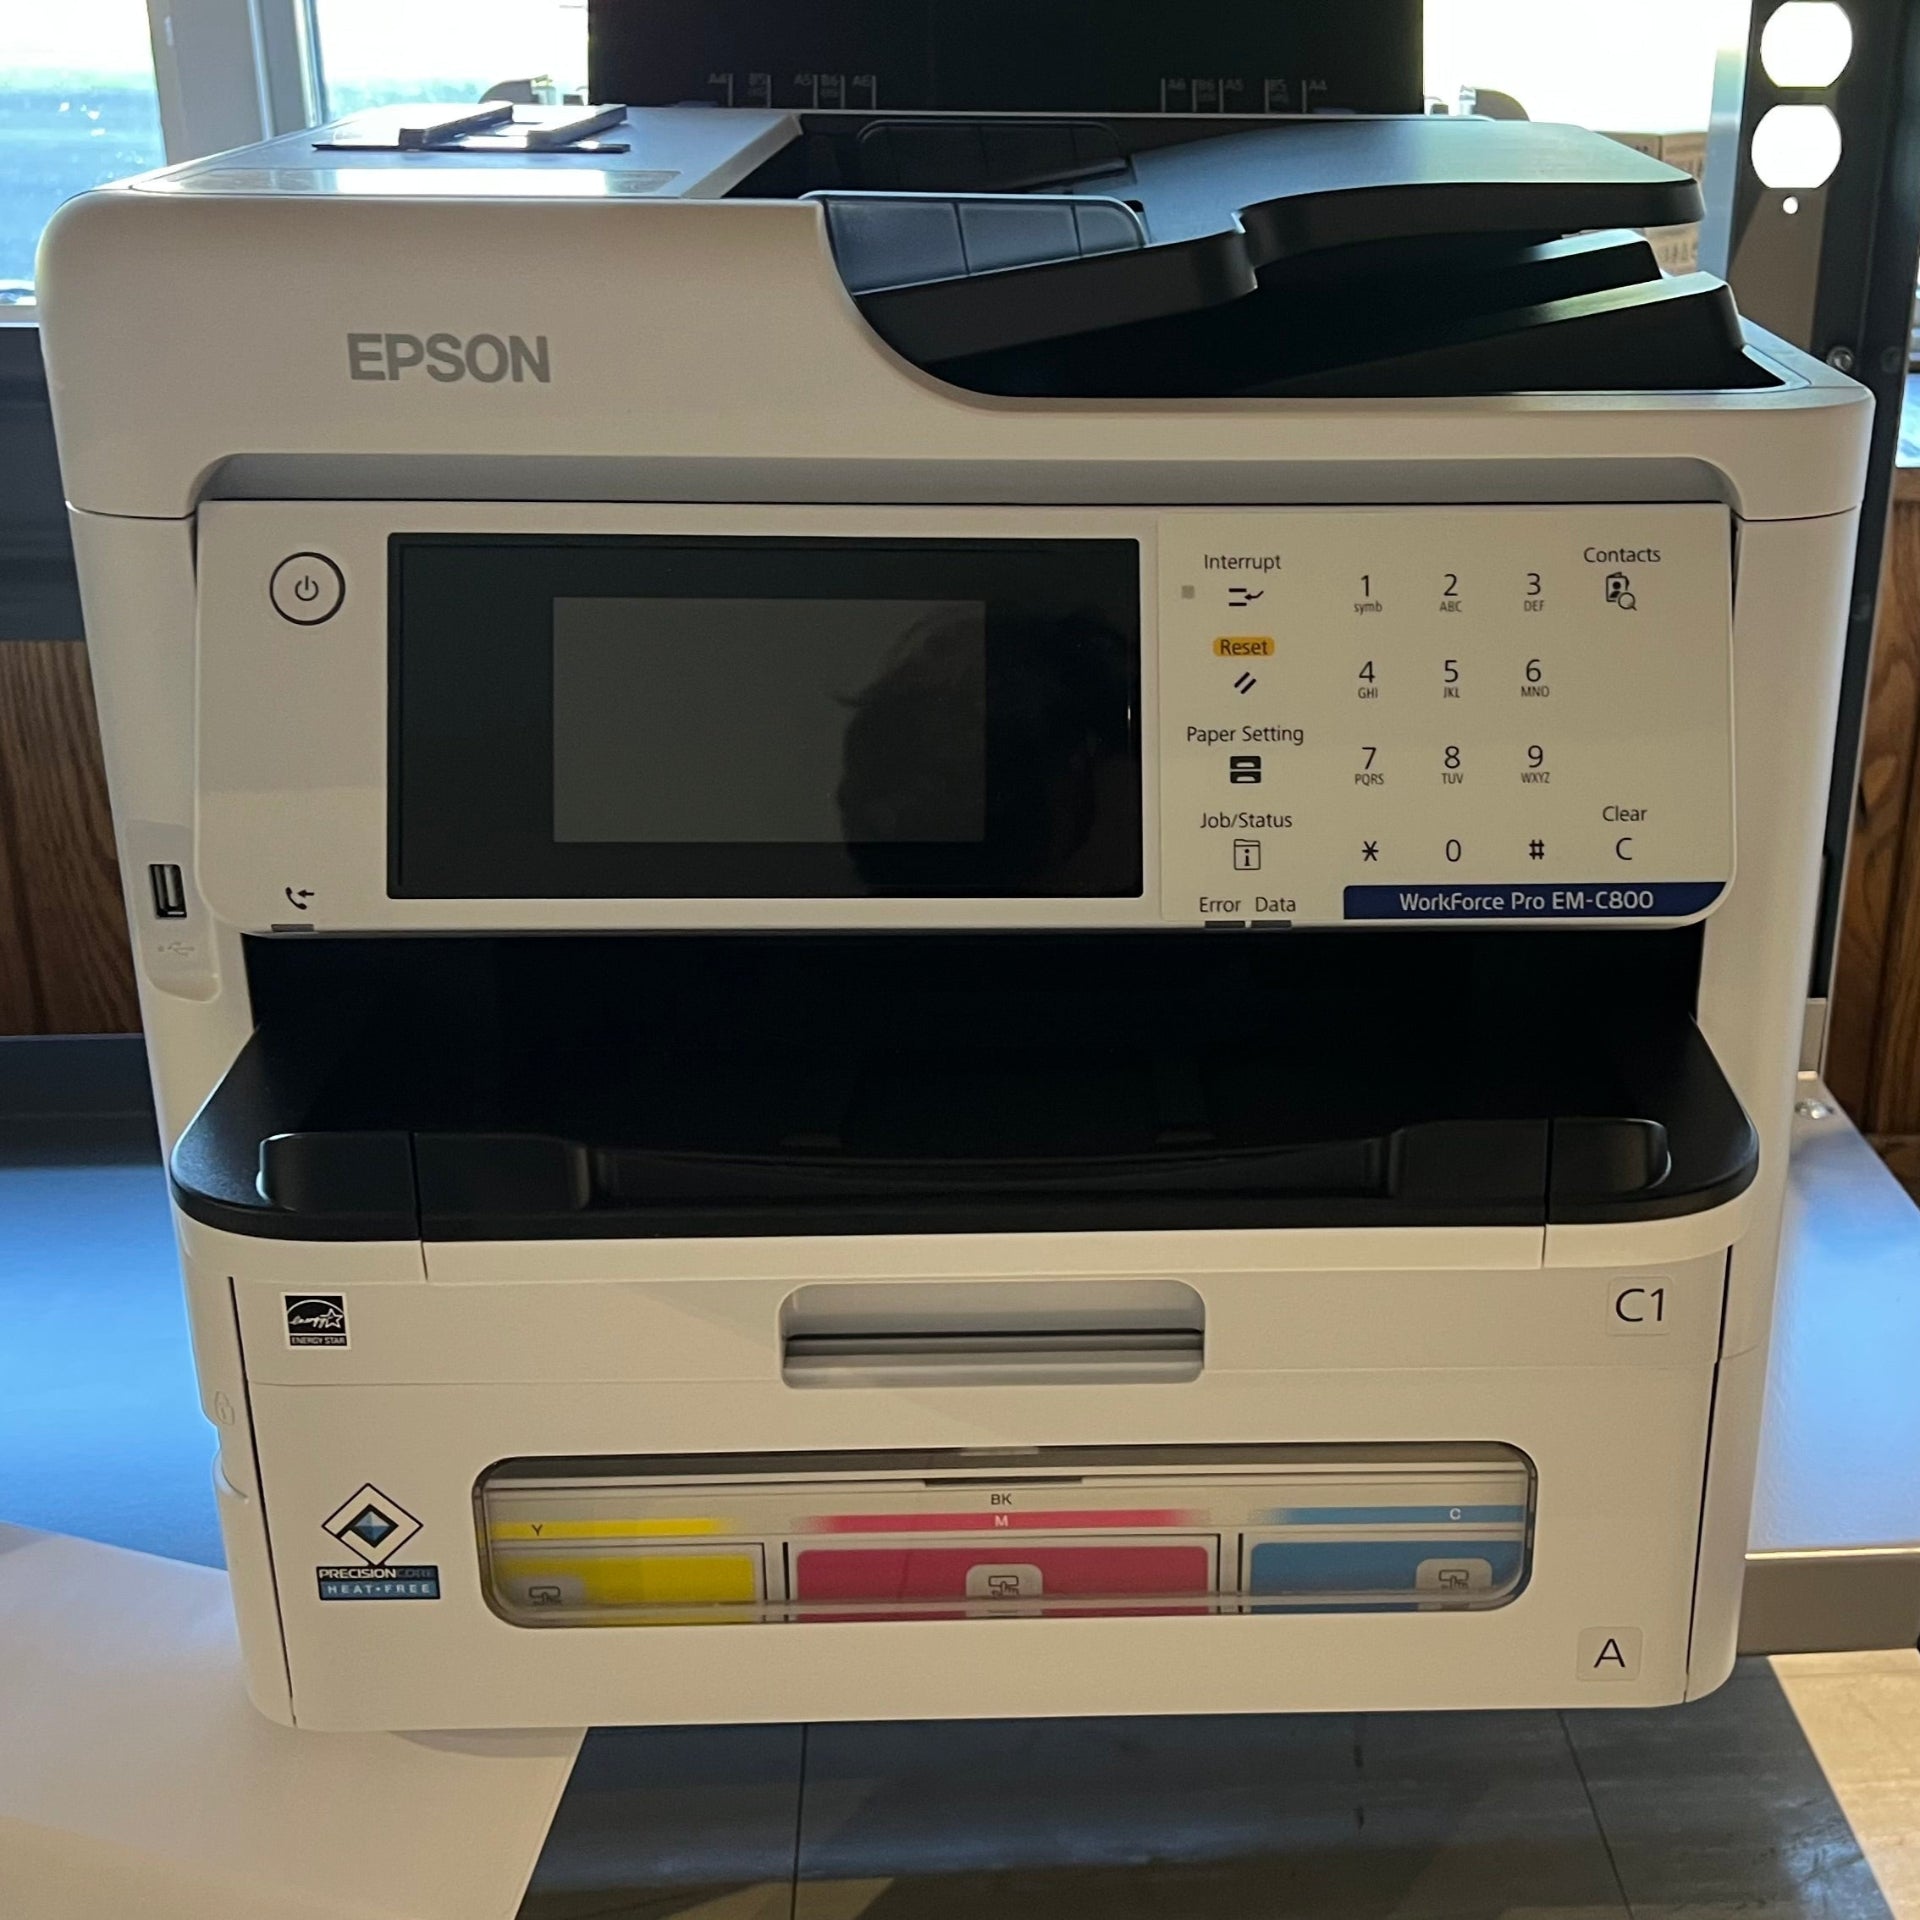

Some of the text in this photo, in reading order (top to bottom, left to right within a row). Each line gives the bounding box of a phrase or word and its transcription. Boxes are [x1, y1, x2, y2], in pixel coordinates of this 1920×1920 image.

[347, 333, 550, 383] EPSON
[1204, 554, 1281, 572] Interrupt
[1584, 546, 1662, 563] Contacts
[1360, 574, 1370, 597] 1
[1443, 574, 1458, 597] 2
[1526, 573, 1542, 596] 3
[1354, 602, 1382, 614] symb
[1439, 600, 1462, 613] ABC
[1523, 599, 1544, 612] DEF
[1220, 639, 1268, 656] Reset
[1359, 660, 1375, 684] 4
[1444, 659, 1459, 683] 5
[1526, 659, 1542, 683] 6
[1357, 687, 1378, 699] GHI
[1443, 687, 1460, 699] JKL
[1521, 685, 1550, 698] MNO
[1187, 725, 1304, 746] Paper Setting
[1362, 746, 1377, 769] 7
[1444, 745, 1461, 769] 8
[1528, 745, 1544, 769] 9
[1354, 773, 1384, 786] PQRS
[1442, 772, 1463, 785] TUV
[1521, 771, 1550, 784] WXYZ
[1200, 811, 1293, 830] Job/Status
[1602, 805, 1648, 822] Clear
[1445, 838, 1462, 863] 0
[1529, 839, 1545, 861] #
[1615, 837, 1633, 861] C
[1199, 896, 1296, 913] Error Data
[1400, 889, 1654, 911] WorkForce Pro EM-C800
[1616, 1287, 1664, 1323] C1
[291, 1336, 345, 1345] ENERGY STAR
[991, 1493, 1012, 1505] BK
[995, 1515, 1008, 1527] M
[1450, 1508, 1462, 1520] C
[531, 1524, 543, 1536] Y
[1593, 1638, 1626, 1669] A
